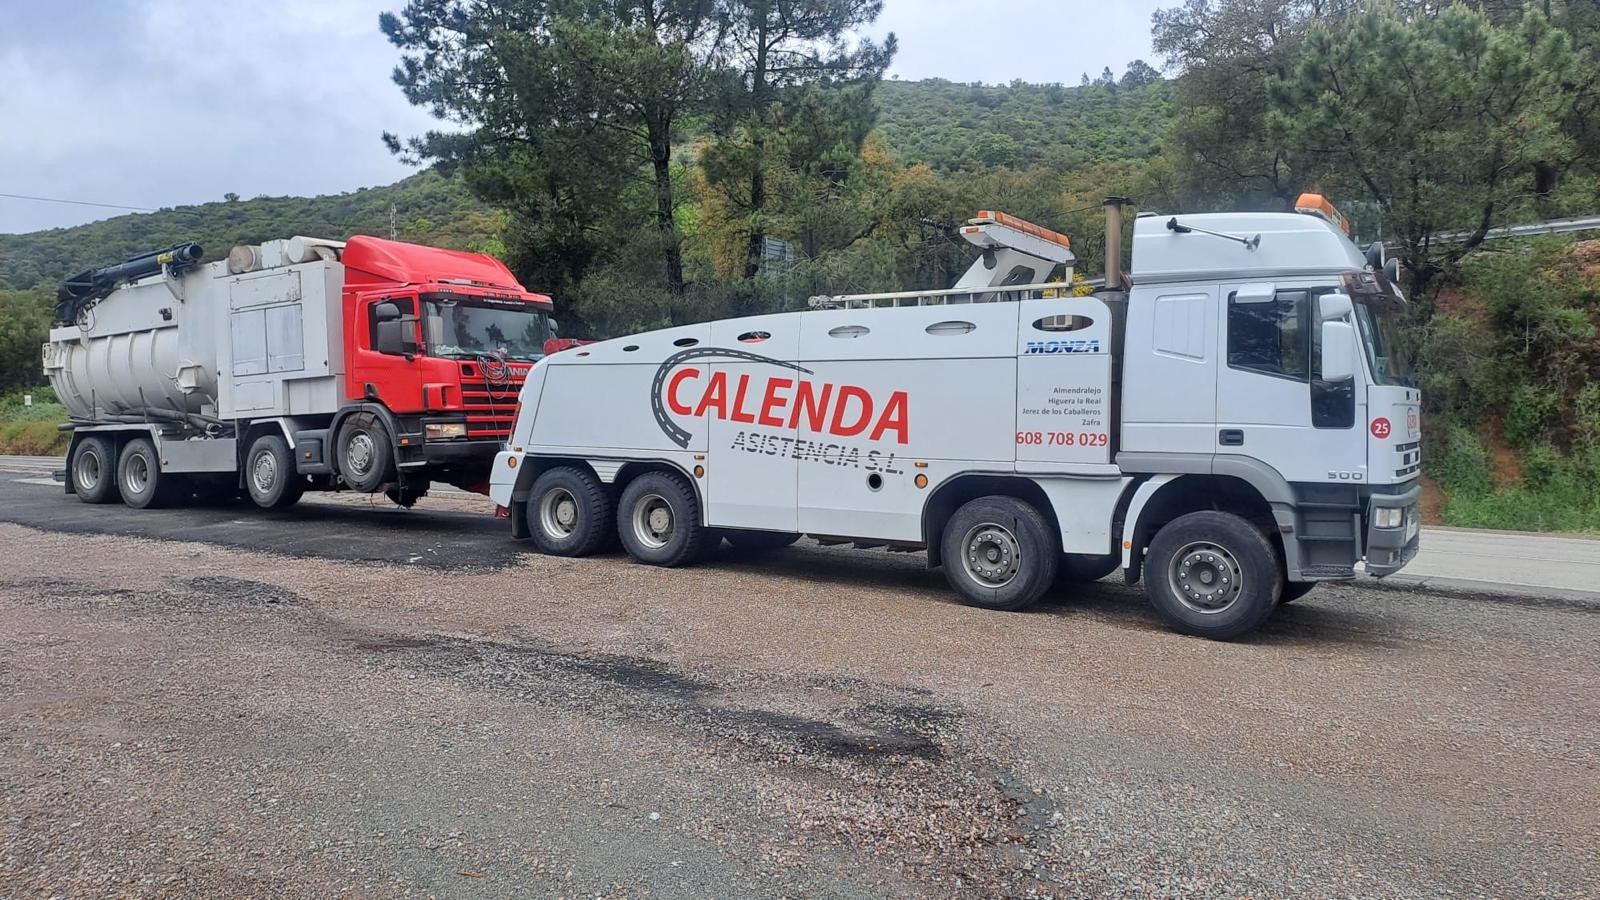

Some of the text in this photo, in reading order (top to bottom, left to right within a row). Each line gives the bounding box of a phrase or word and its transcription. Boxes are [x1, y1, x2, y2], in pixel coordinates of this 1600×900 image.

[1024, 340, 1099, 354] MONZA
[1053, 387, 1102, 395] Almendralejo
[667, 368, 909, 445] CALENDA
[1375, 423, 1389, 434] 25
[1016, 432, 1108, 446] 608 708 029
[731, 432, 904, 475] ASISTENCIA S.L.
[1328, 472, 1362, 480] 500
